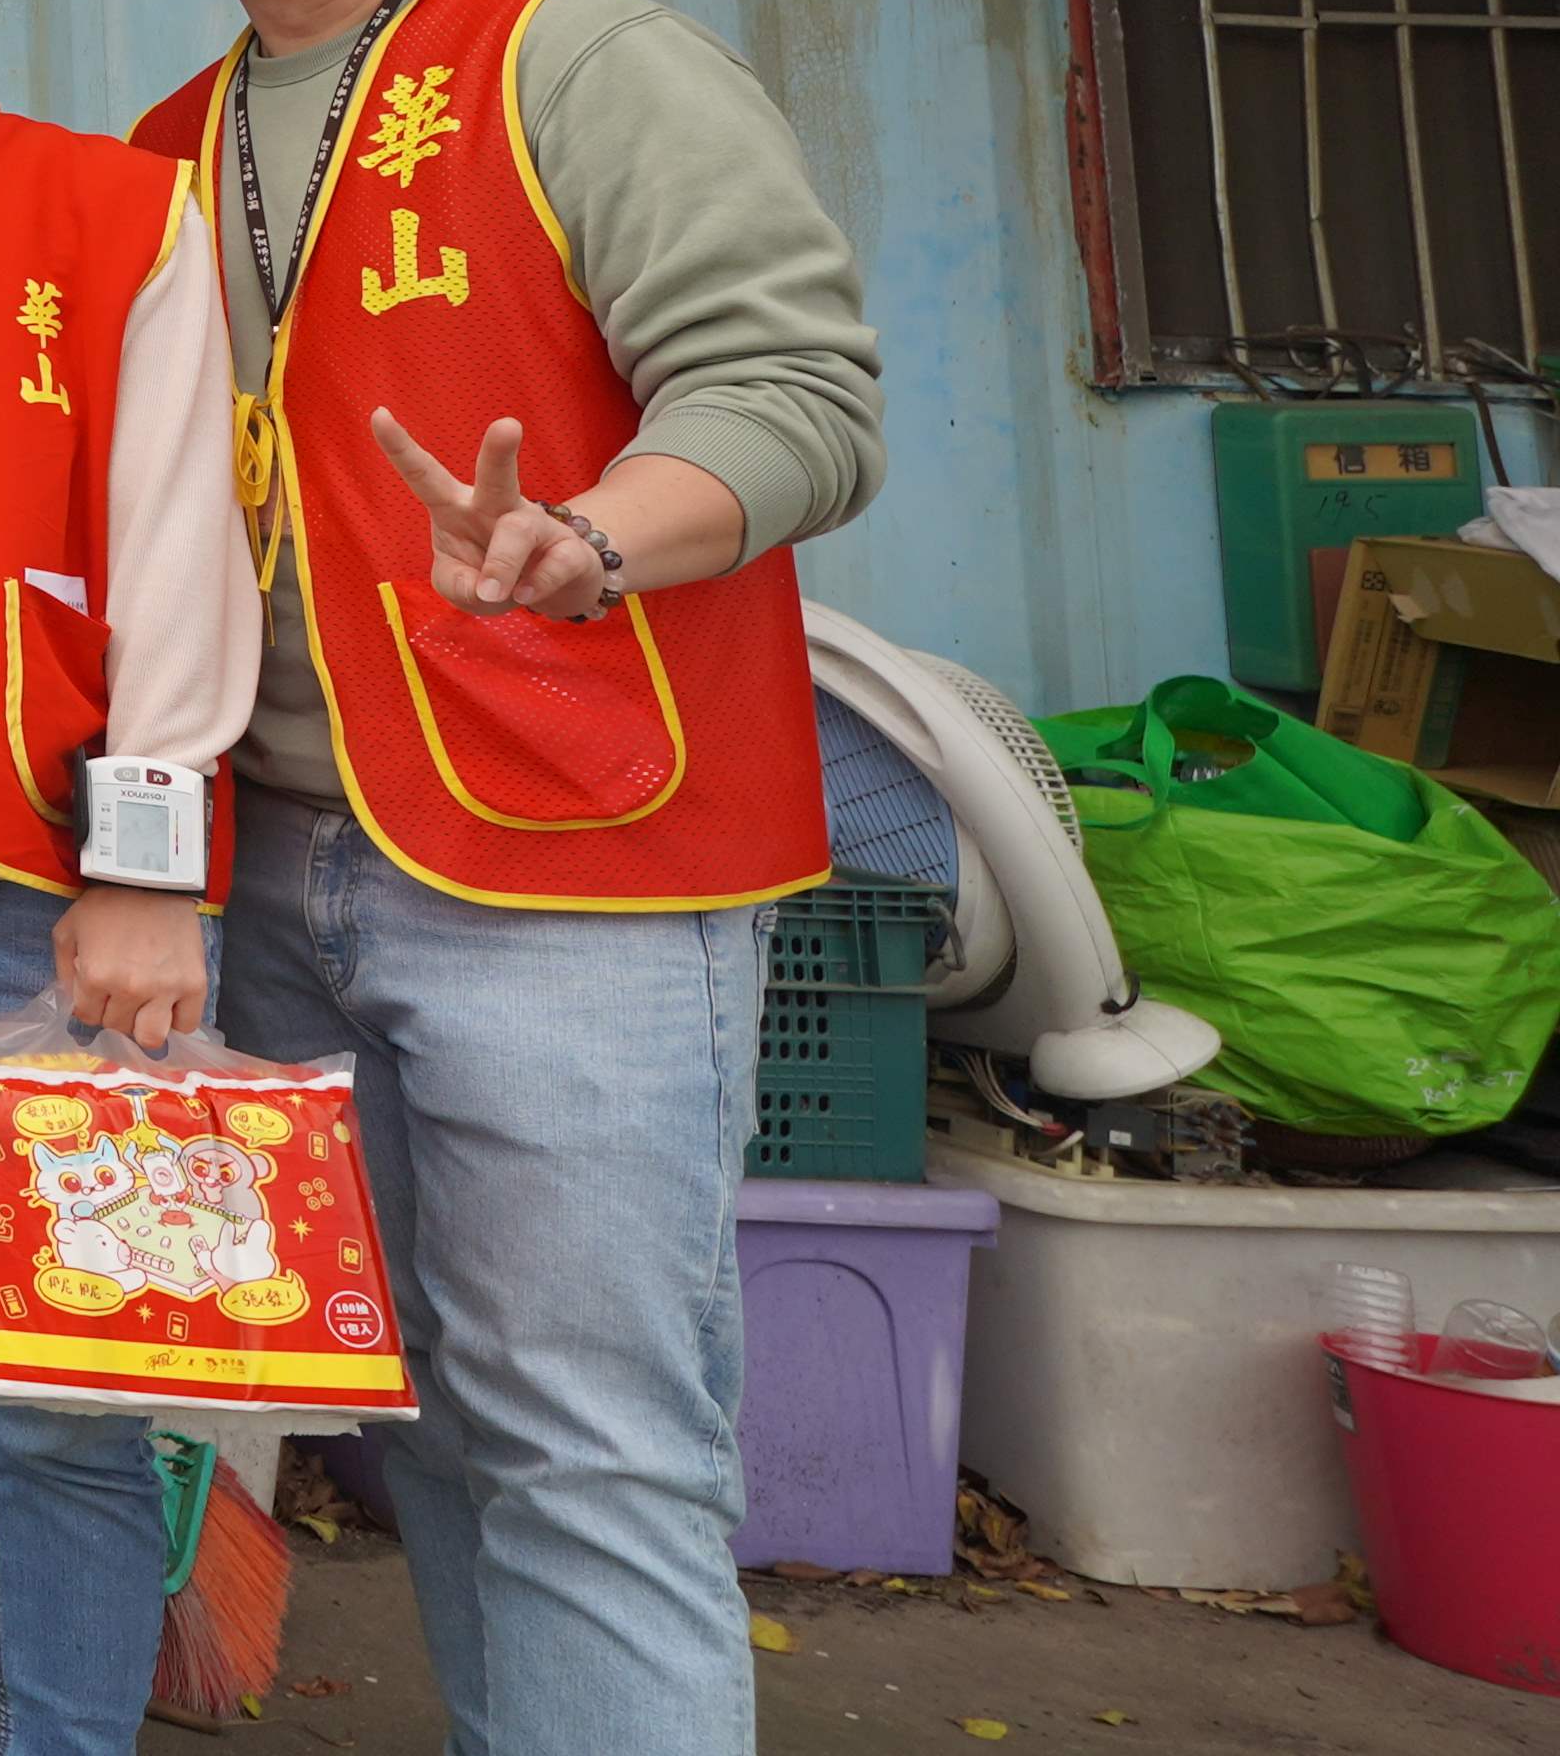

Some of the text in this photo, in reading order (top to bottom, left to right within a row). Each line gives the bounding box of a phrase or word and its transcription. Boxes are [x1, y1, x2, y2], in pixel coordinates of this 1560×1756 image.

[357, 65, 471, 316] 華山
[15, 277, 72, 417] 華山
[1334, 443, 1431, 476] 信箱
[120, 789, 167, 802] rossmax
